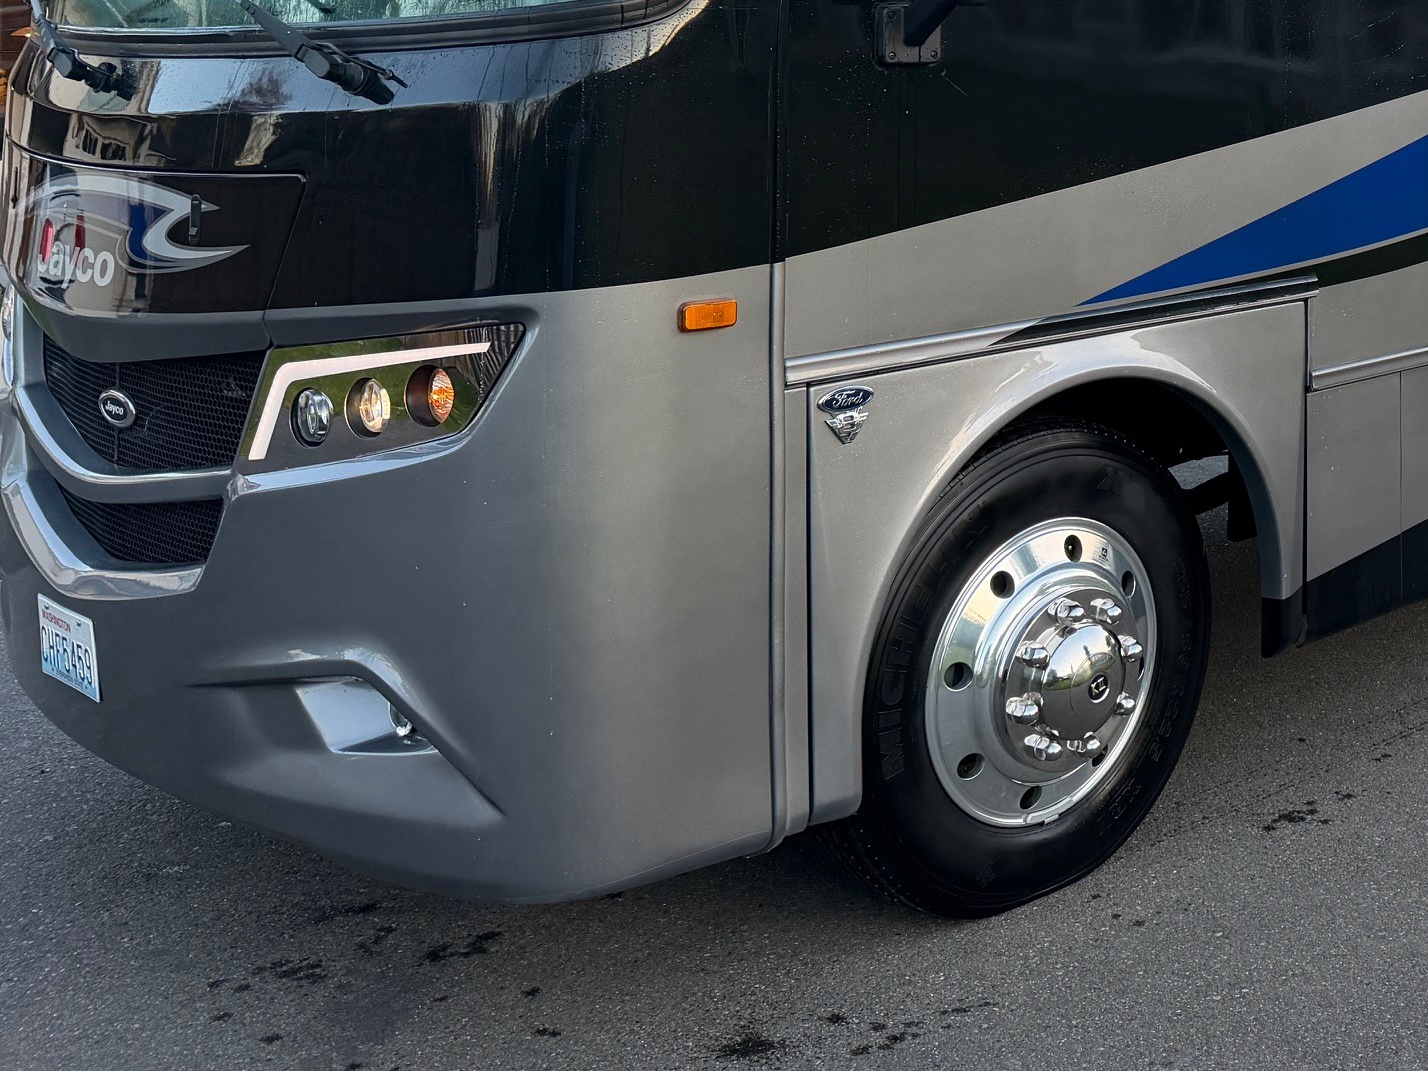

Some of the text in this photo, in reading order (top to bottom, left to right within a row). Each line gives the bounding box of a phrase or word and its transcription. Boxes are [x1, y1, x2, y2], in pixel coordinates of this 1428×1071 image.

[37, 226, 115, 289] Jayco
[105, 400, 124, 416] Jayco
[832, 389, 864, 409] Ford
[41, 609, 72, 634] WASHINGTON
[878, 498, 994, 780] MICHELIN
